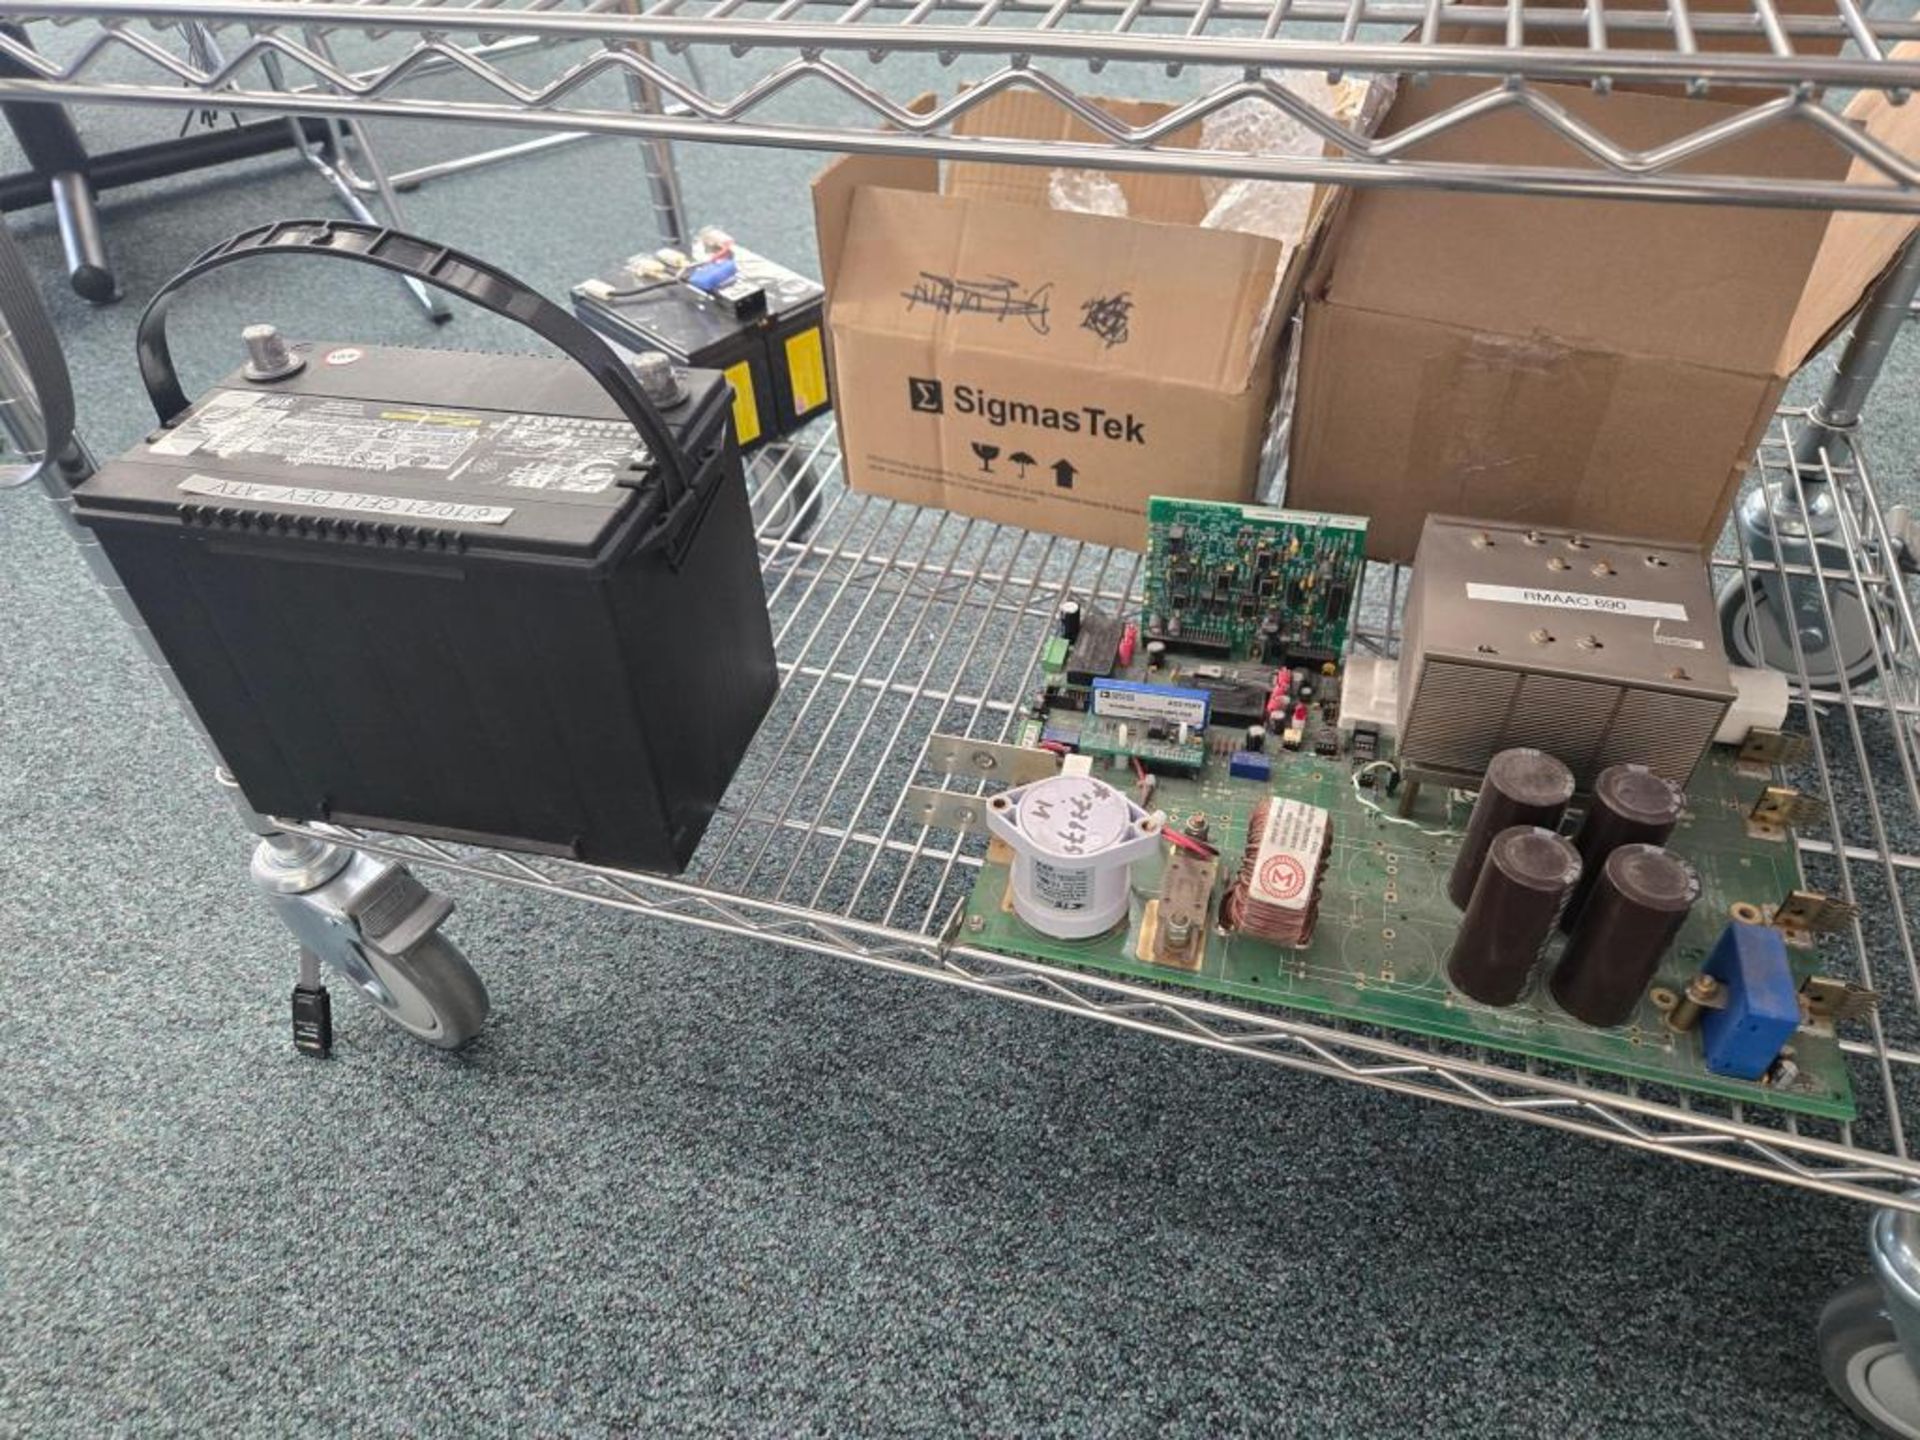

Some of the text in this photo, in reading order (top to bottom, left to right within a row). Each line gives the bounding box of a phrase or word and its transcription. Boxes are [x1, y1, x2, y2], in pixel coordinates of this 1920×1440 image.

[953, 385, 1146, 444] SigmasTek
[1523, 590, 1627, 611] RMAAC 690
